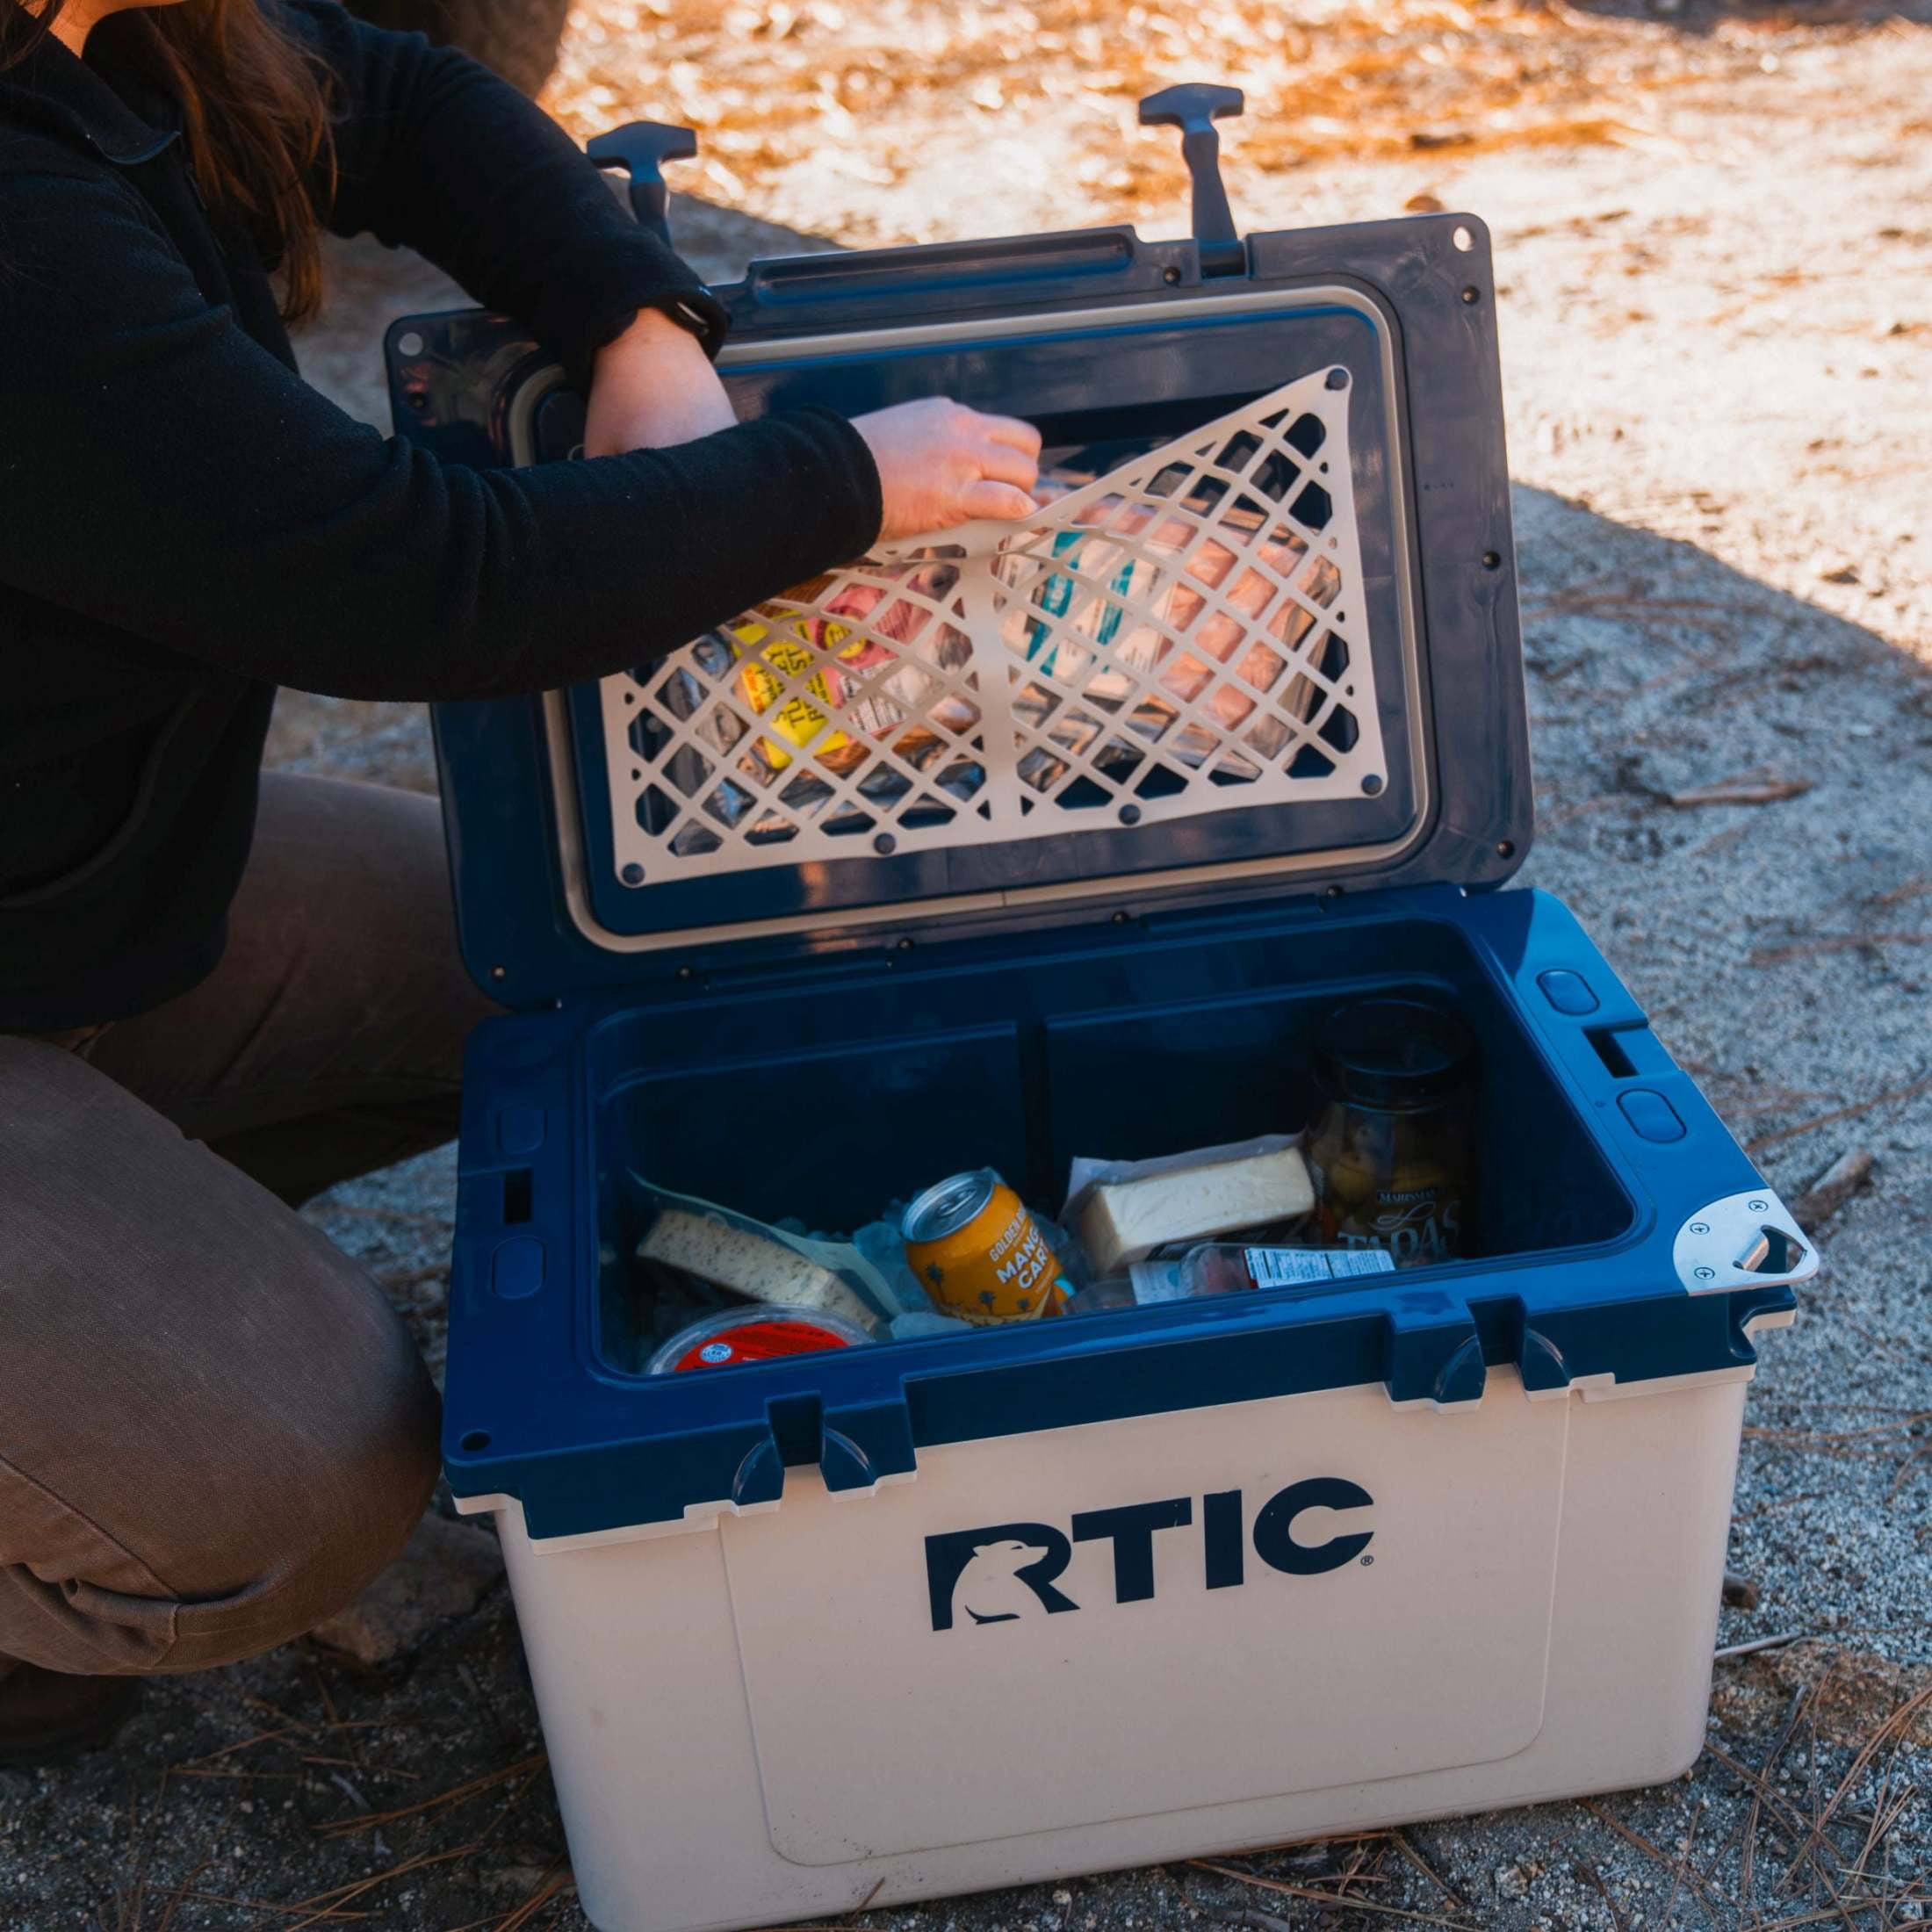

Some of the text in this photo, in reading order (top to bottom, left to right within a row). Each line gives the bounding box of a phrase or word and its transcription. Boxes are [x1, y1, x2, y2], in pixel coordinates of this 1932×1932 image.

[990, 1217, 1021, 1261] GOLDEN
[996, 1224, 1039, 1284] MANG
[925, 1477, 1374, 1631] RTIC
